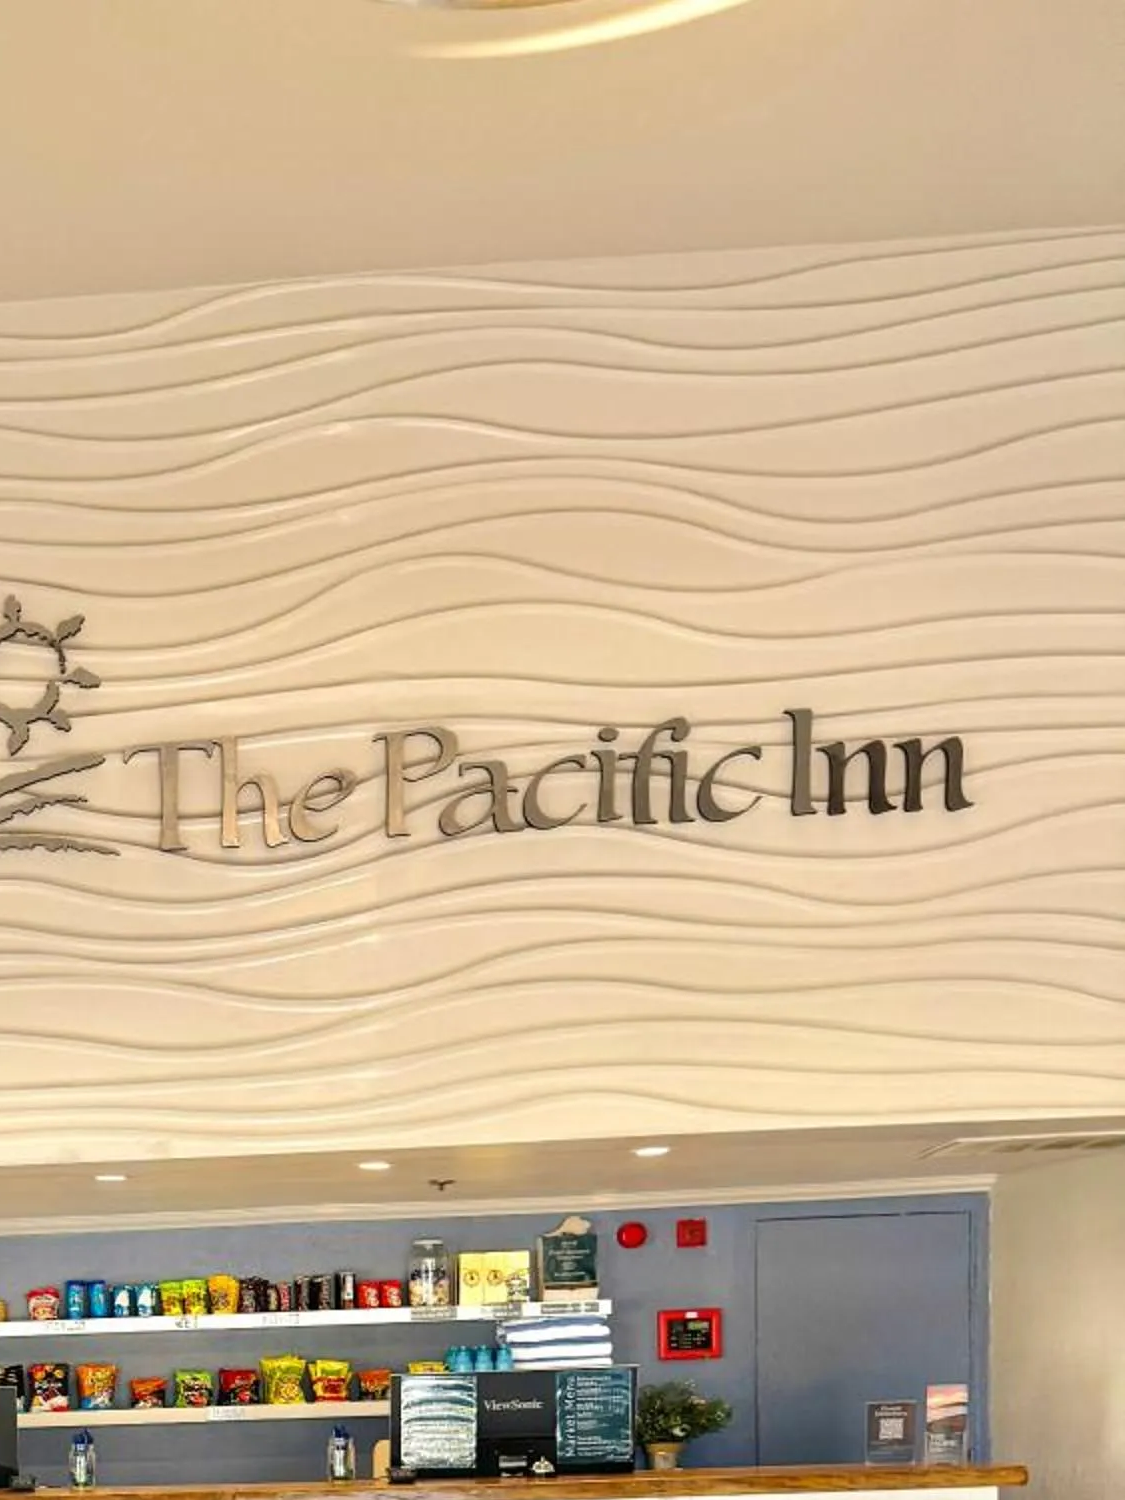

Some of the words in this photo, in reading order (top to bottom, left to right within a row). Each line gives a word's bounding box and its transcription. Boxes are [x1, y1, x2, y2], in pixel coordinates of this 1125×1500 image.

[123, 734, 357, 852] The
[373, 715, 765, 838] Pacific
[783, 708, 976, 816] Inn
[483, 1398, 545, 1411] ViewSonic
